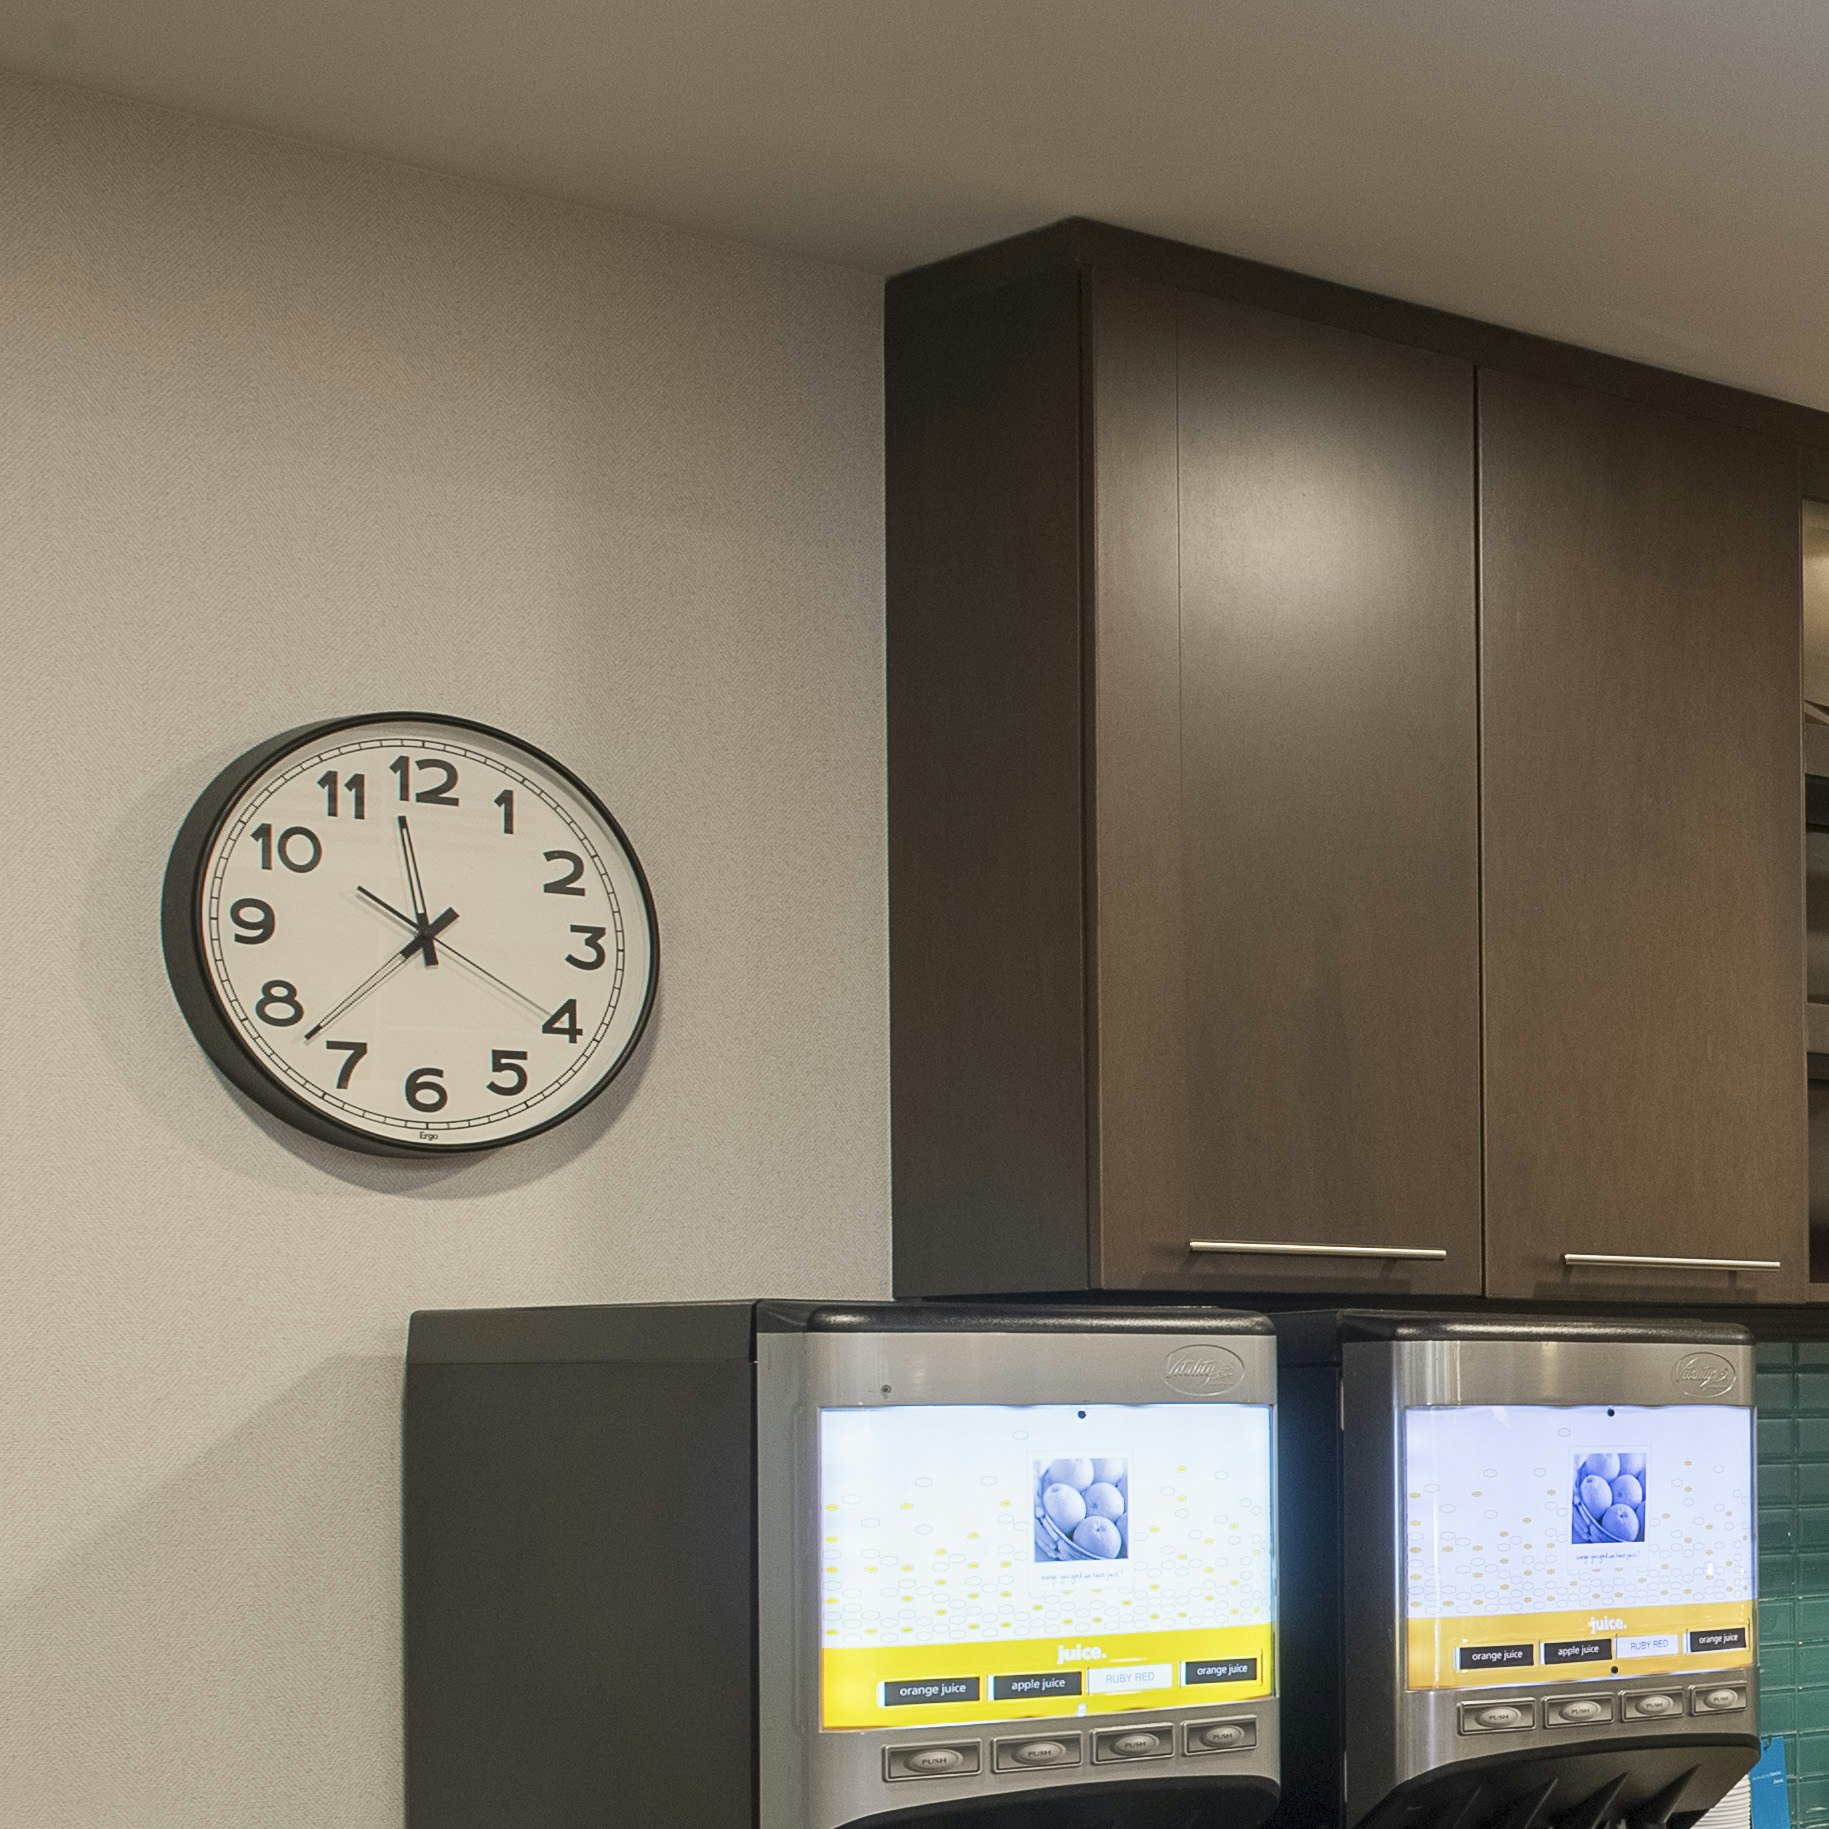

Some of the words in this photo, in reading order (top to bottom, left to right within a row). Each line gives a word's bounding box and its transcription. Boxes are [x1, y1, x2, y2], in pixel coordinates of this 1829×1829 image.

[317, 770, 365, 820] 11
[389, 756, 459, 807] 12
[494, 789, 514, 834] 1
[251, 823, 322, 873] 10
[543, 850, 586, 896] 2
[230, 898, 276, 945] 9
[564, 924, 607, 970] 3
[255, 980, 304, 1027] 8
[541, 998, 583, 1043] 4
[325, 1040, 368, 1089] 7
[486, 1049, 528, 1096] 5
[404, 1067, 448, 1113] 6
[419, 1131, 439, 1141] Ergo
[1588, 1616, 1627, 1634] juice.
[1699, 1636, 1723, 1645] orange
[1723, 1633, 1738, 1644] juice
[1056, 1643, 1107, 1665] juice.
[1472, 1652, 1502, 1663] orange
[1503, 1649, 1523, 1661] juice
[1558, 1646, 1581, 1657] apple
[1581, 1644, 1599, 1656] juice
[1631, 1641, 1651, 1650] RUBY
[1653, 1639, 1669, 1648] RED
[1011, 1679, 1040, 1691] apple
[1042, 1677, 1066, 1690] juice
[1105, 1673, 1131, 1684] RUBY
[1135, 1672, 1154, 1682] RED
[1197, 1665, 1227, 1677] orange
[1228, 1663, 1248, 1675] juice
[900, 1684, 939, 1697] orange
[941, 1683, 966, 1696] juice
[921, 1757, 947, 1765] PUSH
